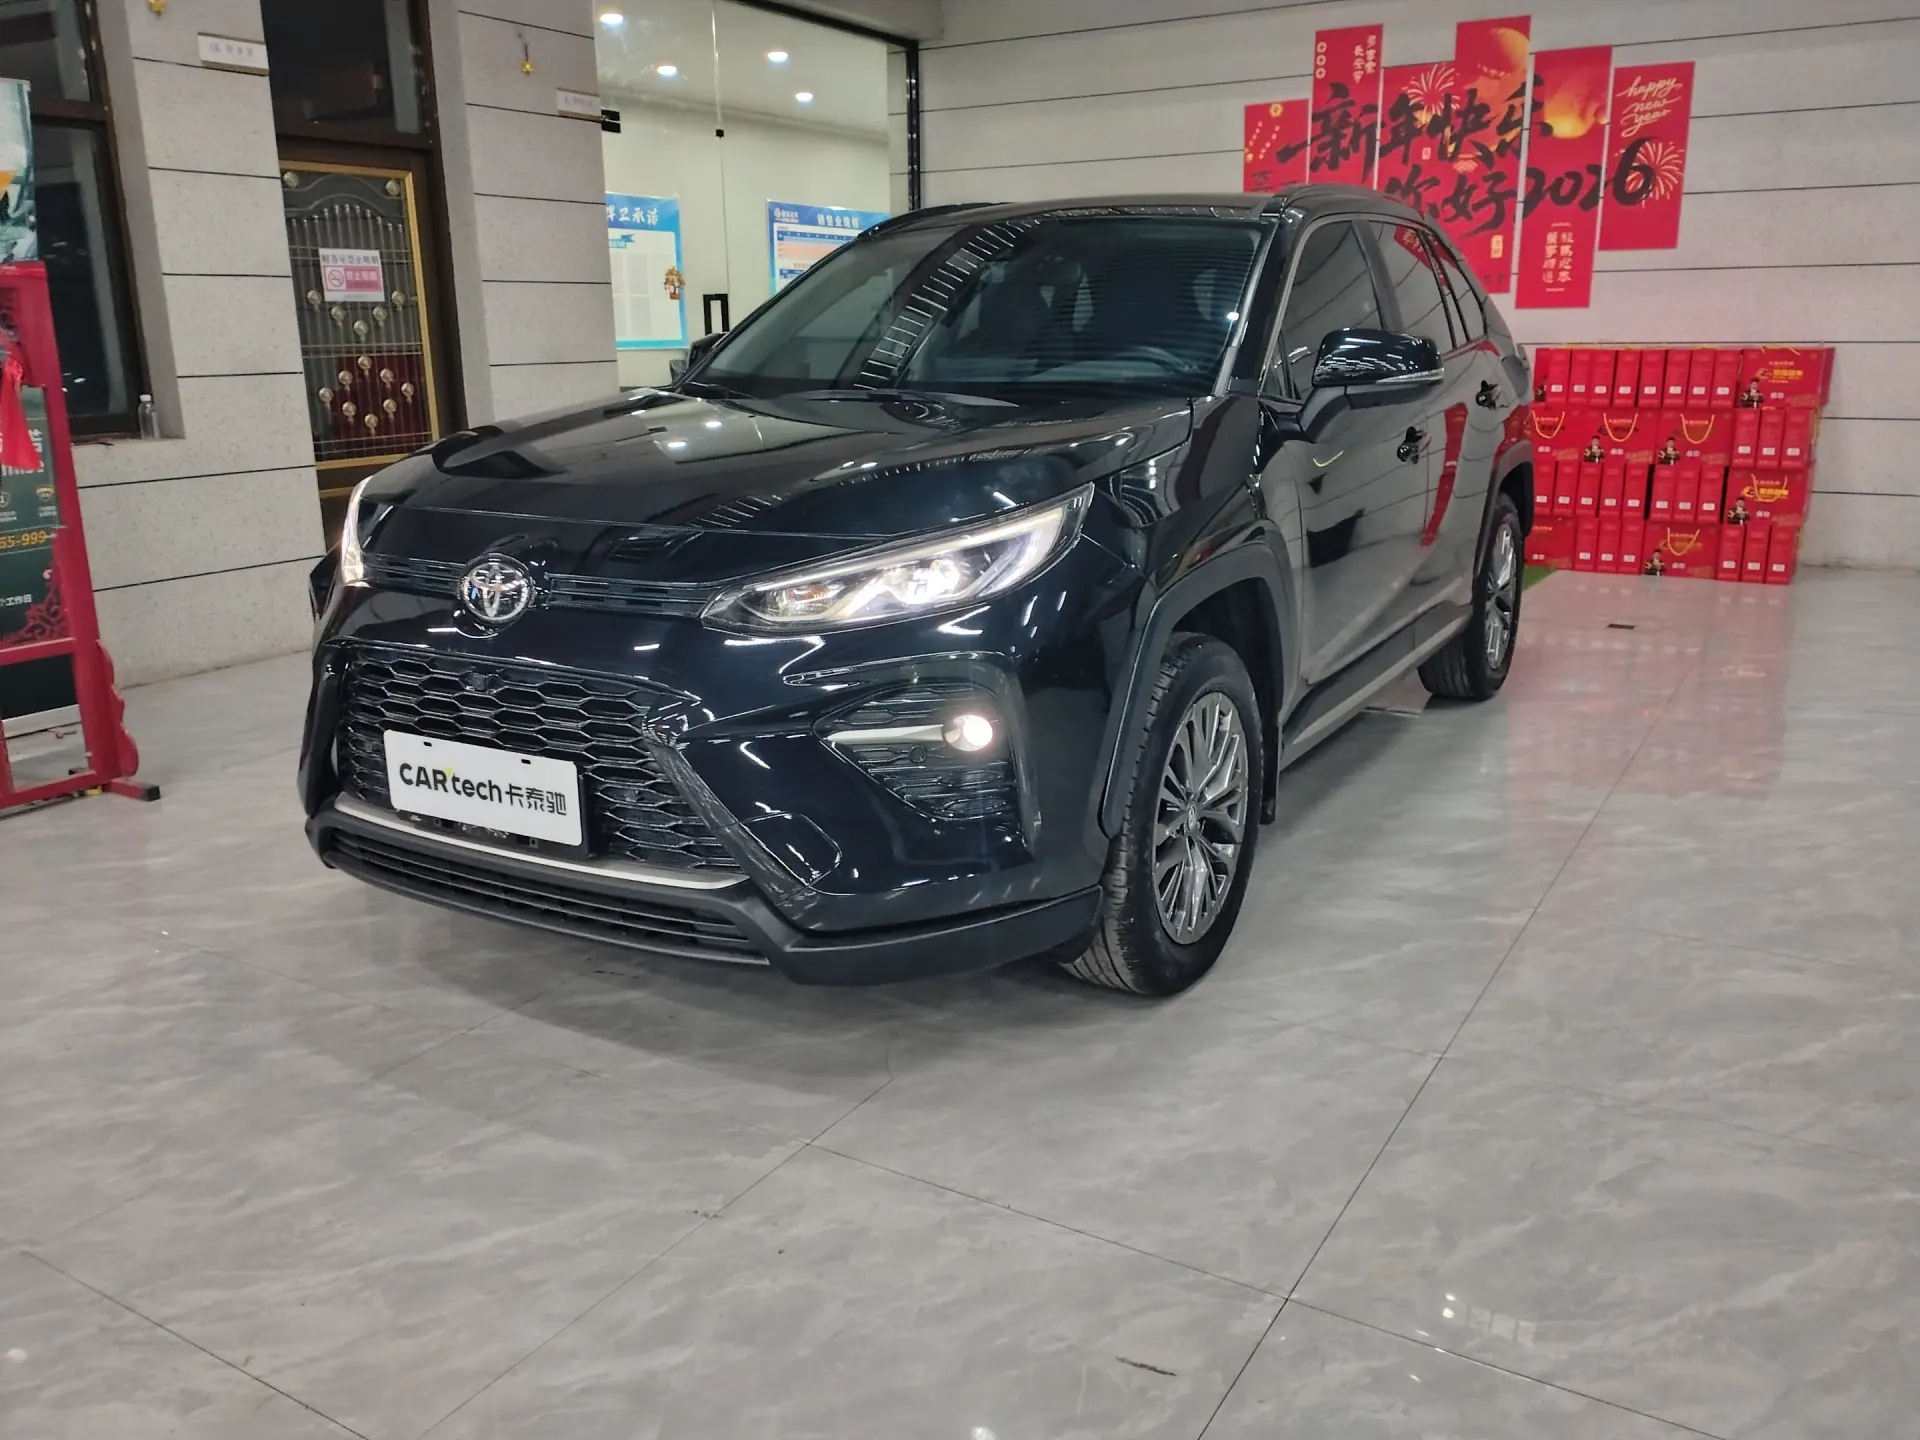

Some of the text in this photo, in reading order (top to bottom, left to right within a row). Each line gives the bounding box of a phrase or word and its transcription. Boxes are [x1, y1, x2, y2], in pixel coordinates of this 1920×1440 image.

[1616, 76, 1683, 100] happy
[1622, 96, 1682, 114] new
[1276, 73, 1554, 183] 新年快乐
[1620, 109, 1671, 137] year
[399, 762, 567, 816] CARtech 卡泰驰
